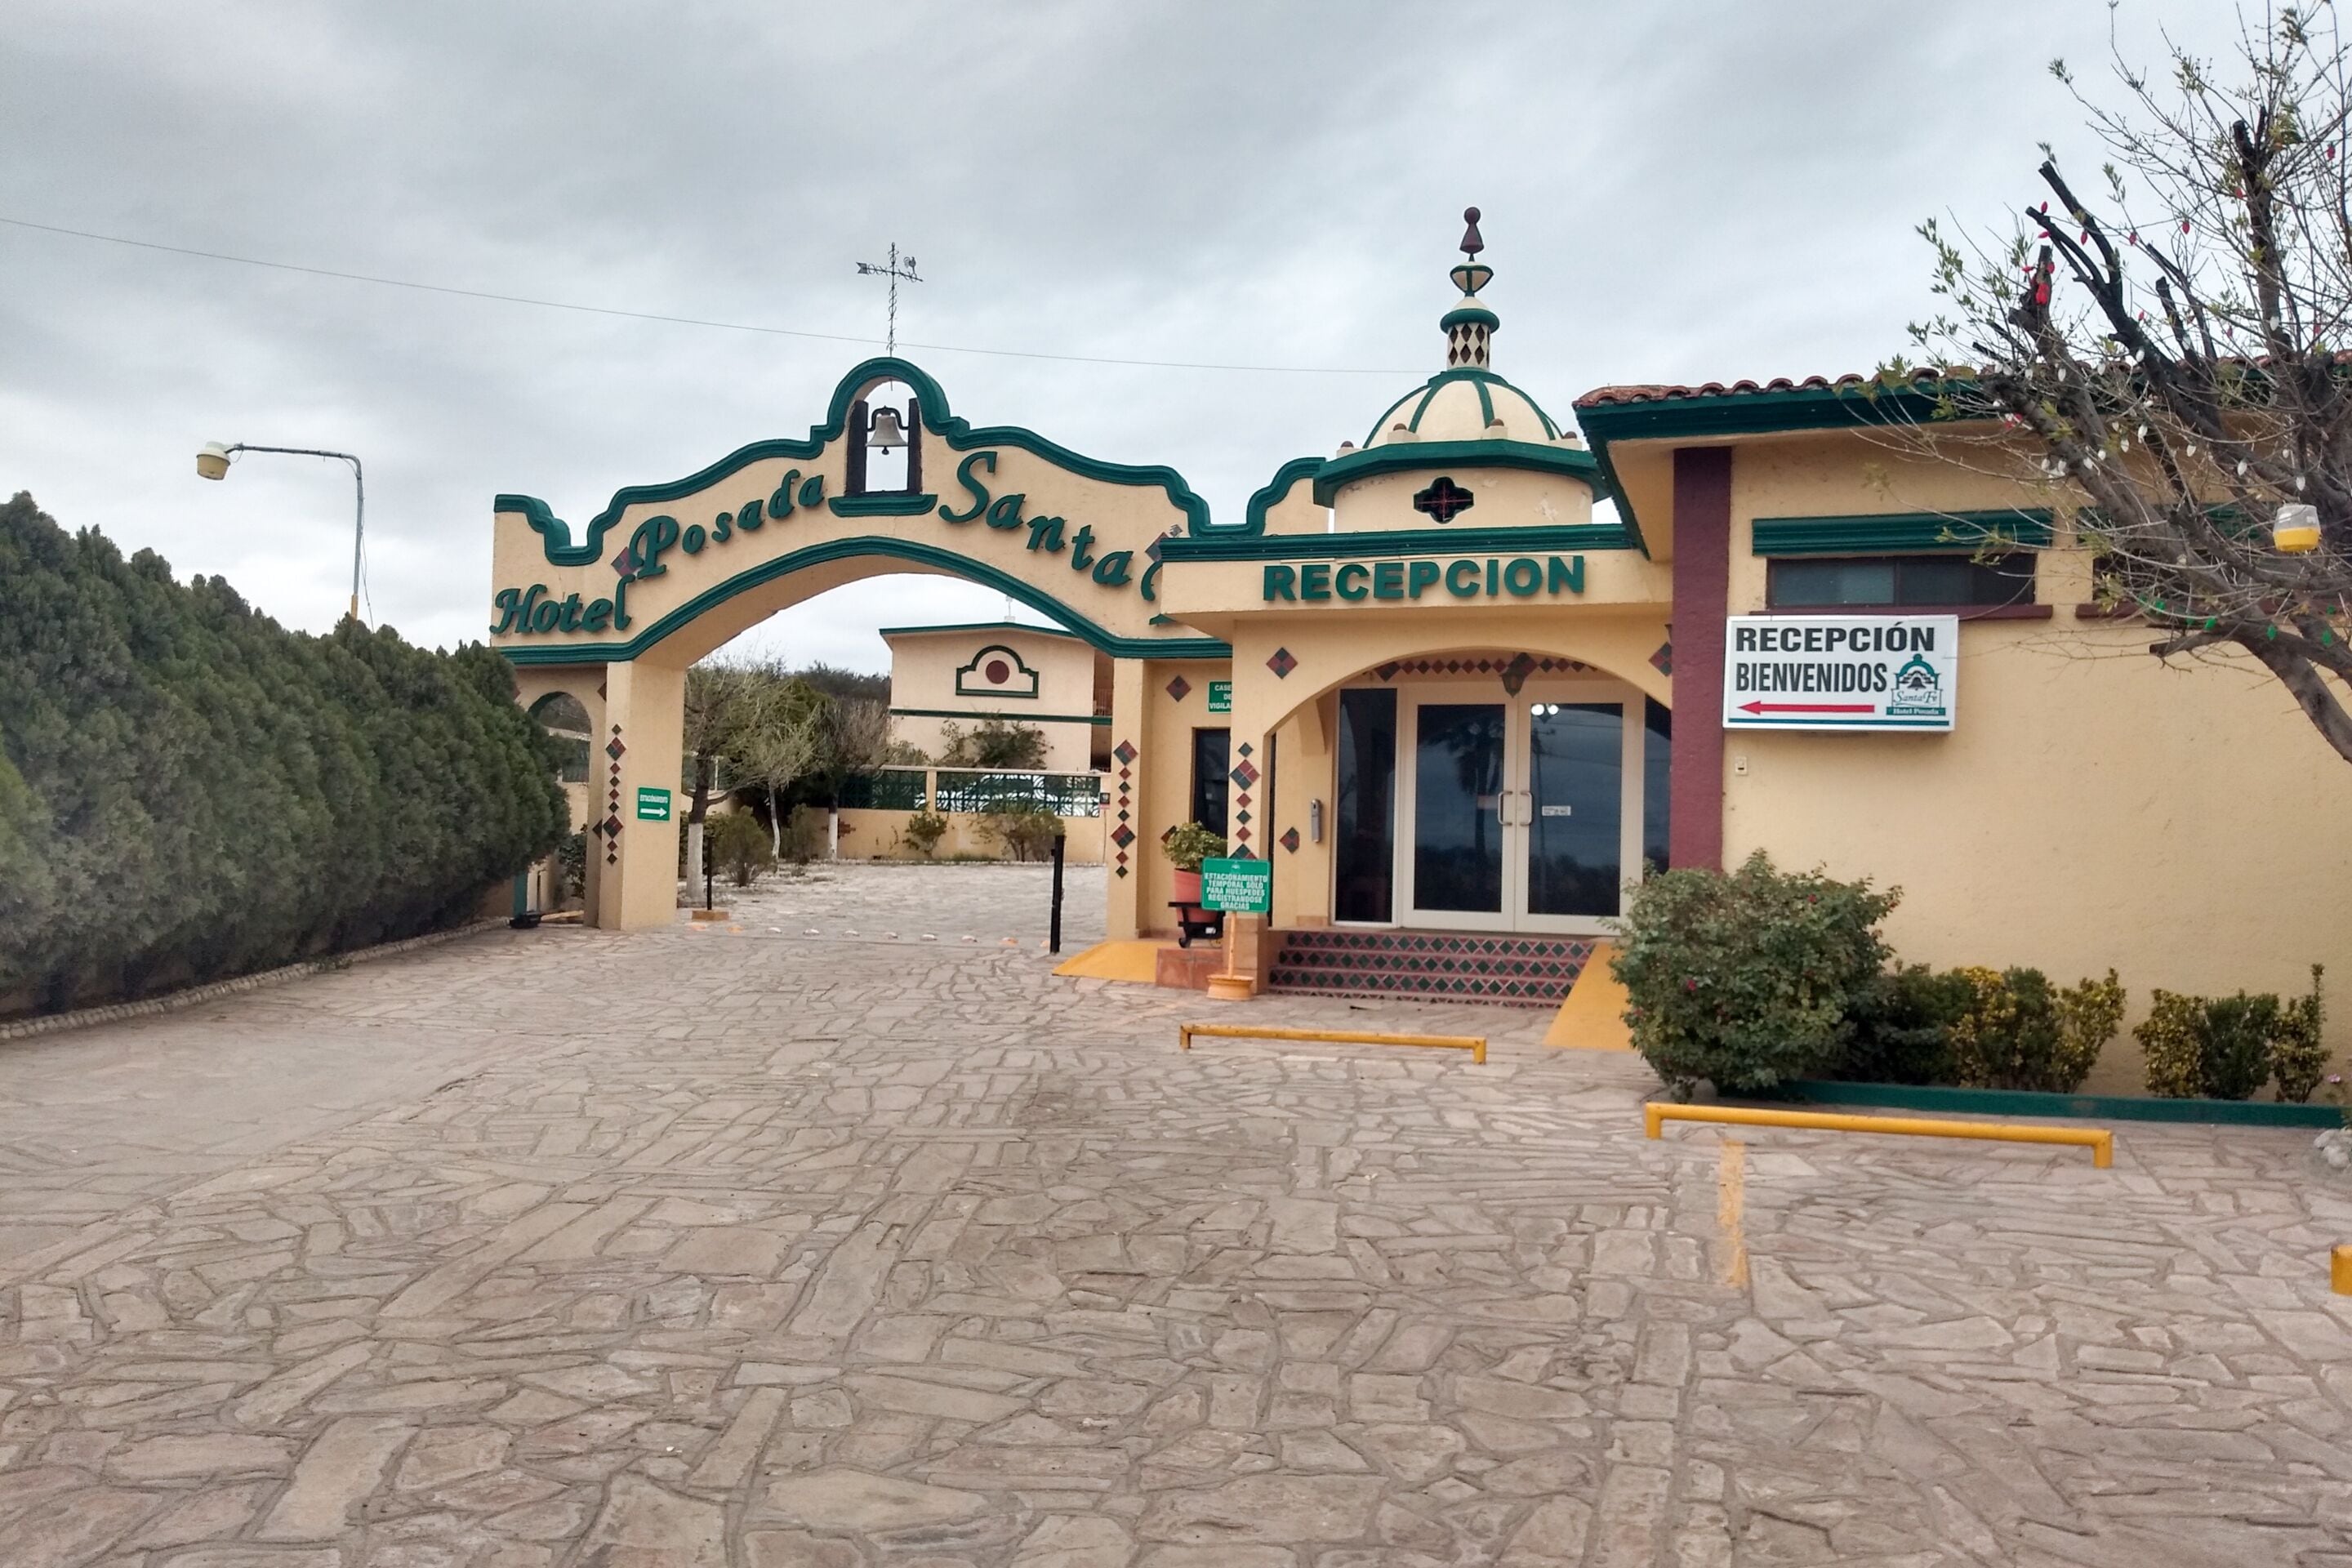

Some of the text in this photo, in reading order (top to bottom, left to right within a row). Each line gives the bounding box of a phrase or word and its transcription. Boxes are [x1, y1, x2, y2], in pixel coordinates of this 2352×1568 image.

[489, 451, 1134, 634] Hotel Posada Santa
[1263, 555, 1584, 601] RECEPCION
[1736, 622, 1935, 652] RECEPCIÓN
[1736, 663, 1887, 692] BIENVENIDOS
[1893, 691, 1937, 704] Santa Fe
[1205, 873, 1267, 883] ESTACIONAMIENTO
[1209, 880, 1244, 889] TEMPORAL
[1220, 902, 1250, 910] GRACIAS
